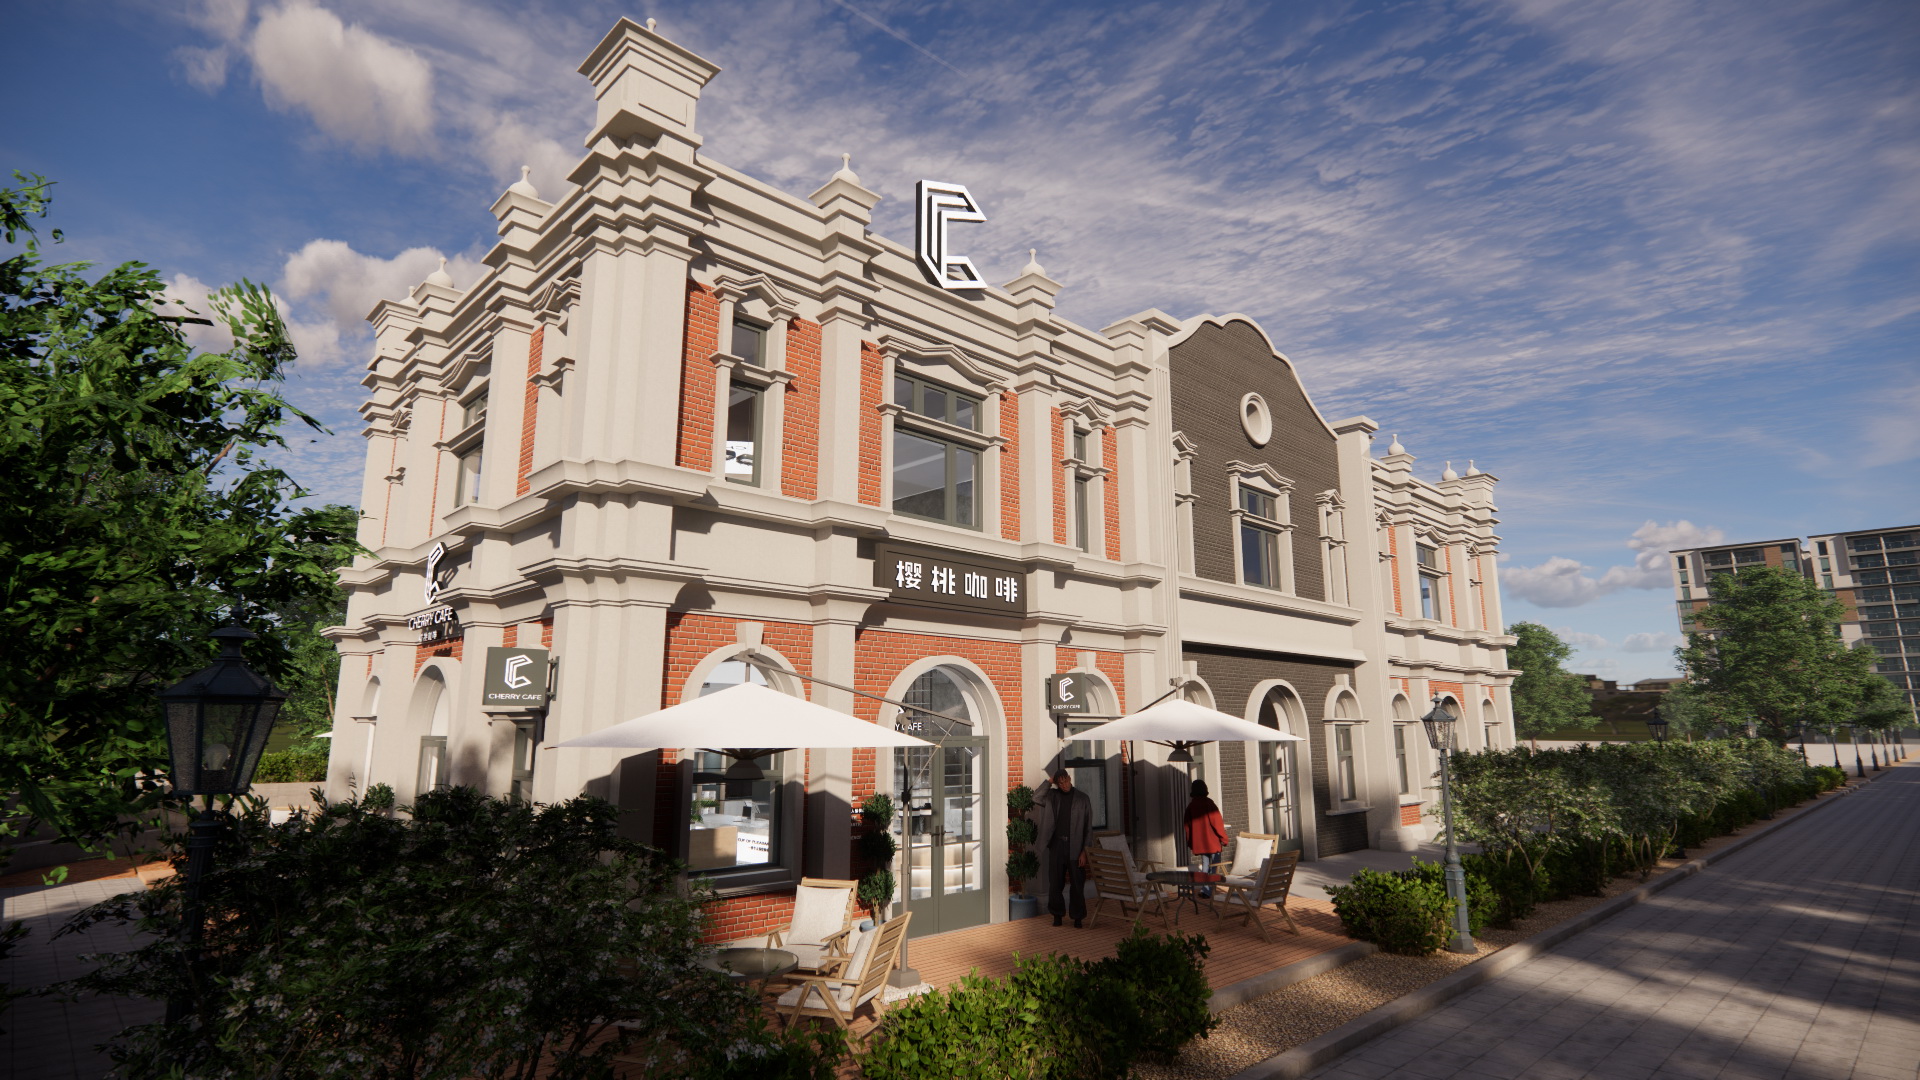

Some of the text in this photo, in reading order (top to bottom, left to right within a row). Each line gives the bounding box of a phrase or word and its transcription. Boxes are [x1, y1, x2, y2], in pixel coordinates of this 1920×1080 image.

[895, 560, 1018, 603] 樱桃咖啡
[408, 607, 454, 631] CHERRY CAFE
